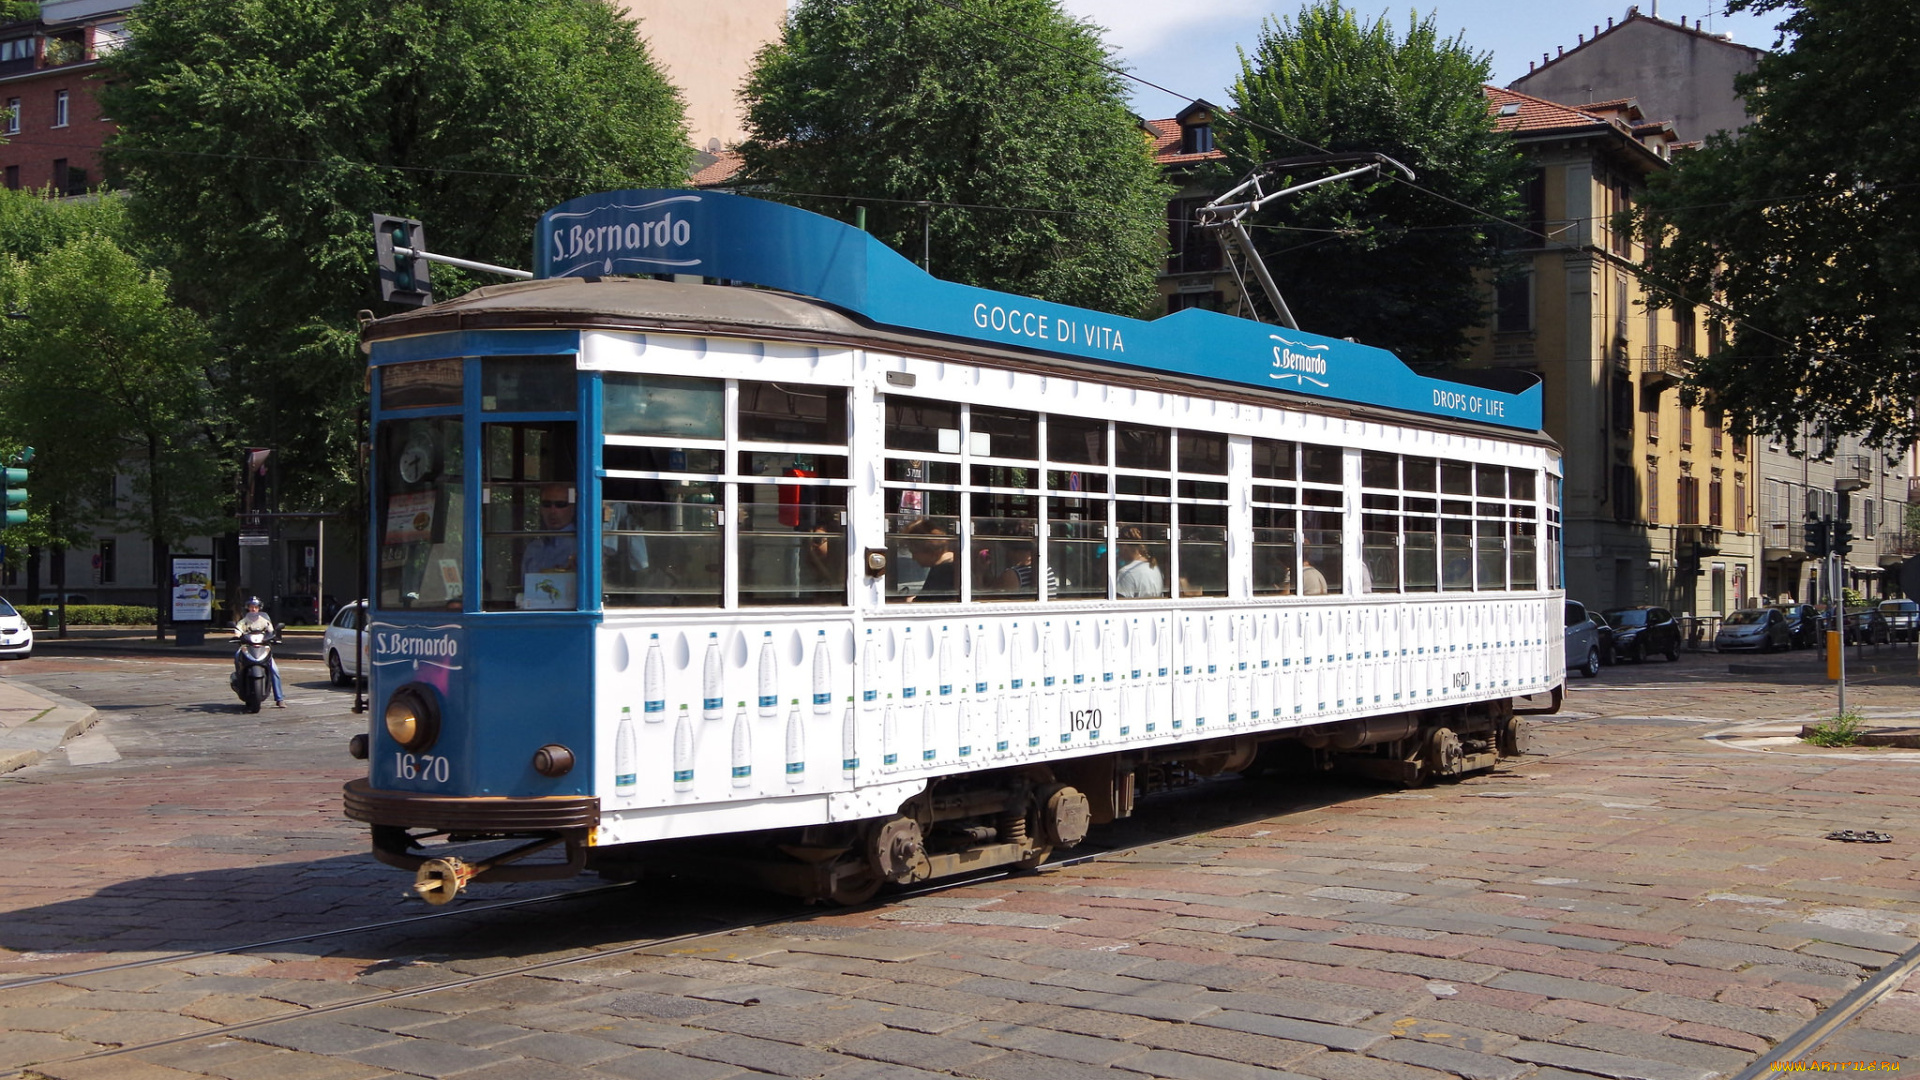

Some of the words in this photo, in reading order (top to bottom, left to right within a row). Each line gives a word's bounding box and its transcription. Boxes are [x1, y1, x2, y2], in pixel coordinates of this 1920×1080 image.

[552, 212, 691, 262] S.Bernardo
[973, 303, 1049, 340] GOCCE
[1057, 319, 1076, 344] DI
[1084, 323, 1124, 352] VITA
[1272, 346, 1327, 376] S.Bernardo
[1433, 390, 1466, 411] DROPS
[1469, 396, 1483, 413] OF
[1486, 399, 1505, 418] LIFE
[376, 632, 458, 657] S.Bernardo
[1453, 671, 1470, 688] 1670
[1070, 708, 1102, 732] 1670
[395, 752, 450, 782] 1670
